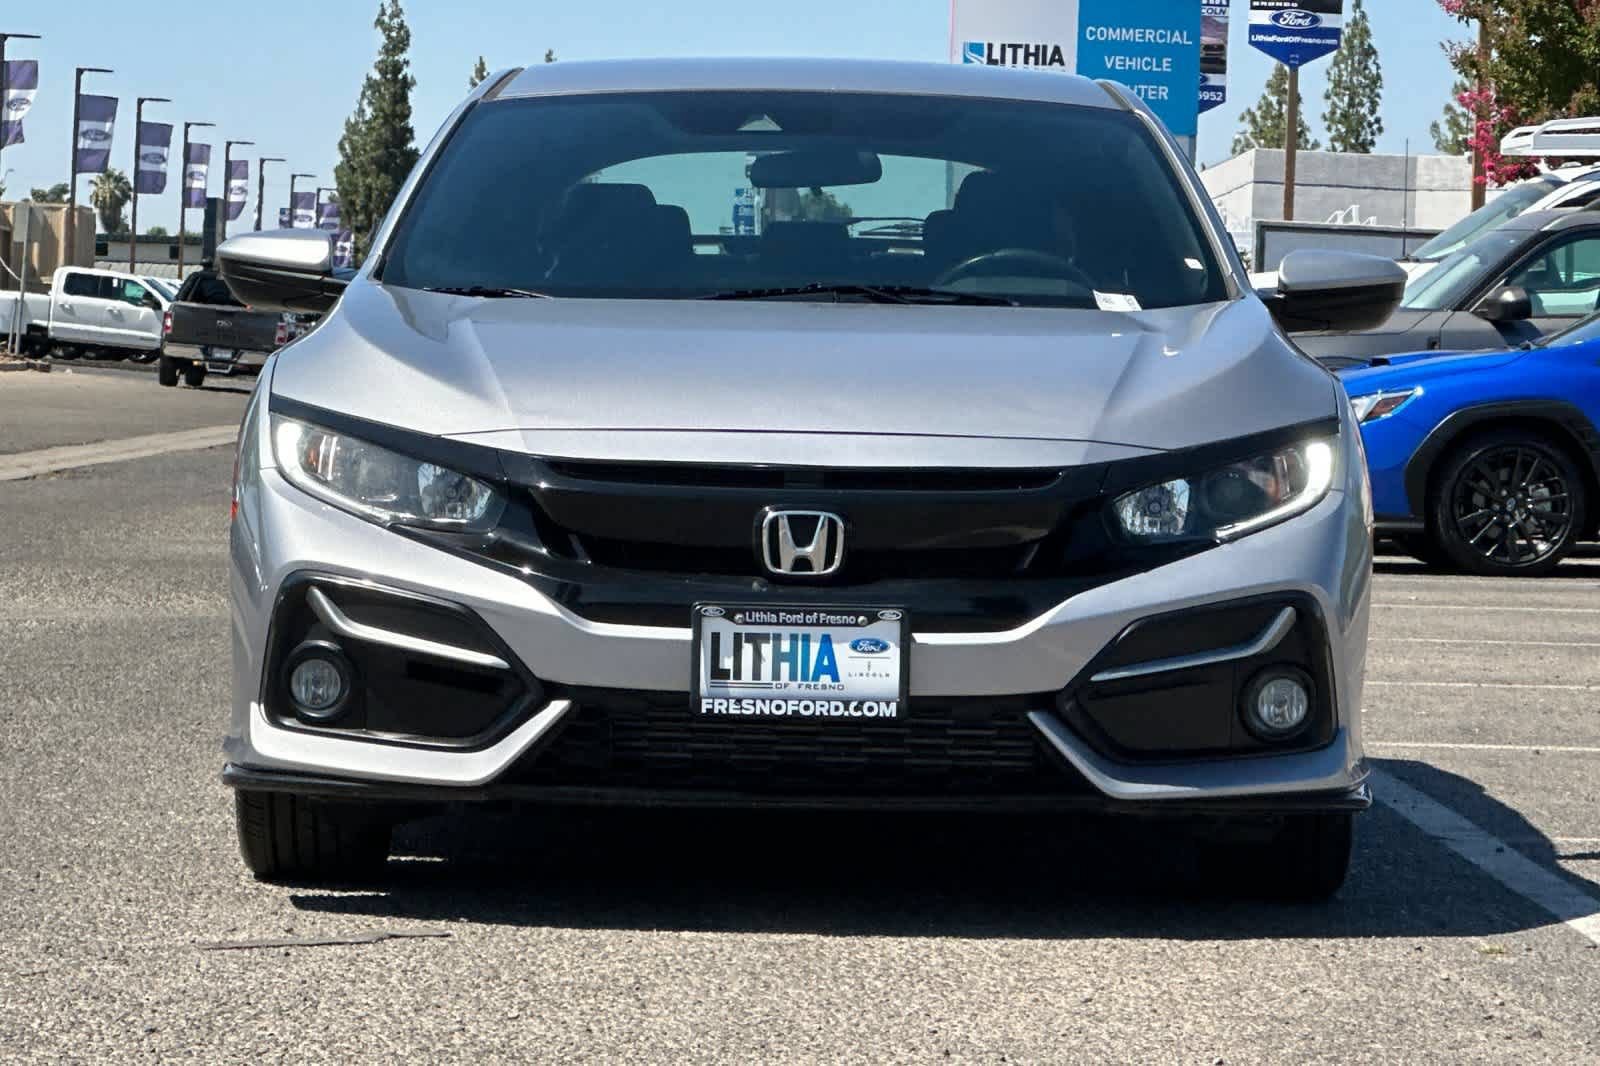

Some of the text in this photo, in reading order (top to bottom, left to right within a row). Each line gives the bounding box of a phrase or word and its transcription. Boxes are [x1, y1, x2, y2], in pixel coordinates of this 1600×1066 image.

[1277, 10, 1314, 27] Ford
[1085, 26, 1193, 45] COMMERCIAL
[987, 42, 1065, 67] LITHIA
[1104, 55, 1172, 72] VEHICLE
[745, 611, 856, 625] Lithia Ford of Fresno
[710, 632, 841, 683] LITHIA
[775, 682, 845, 691] OF FRESNO
[701, 699, 897, 718] FRESNOFORD.COM
